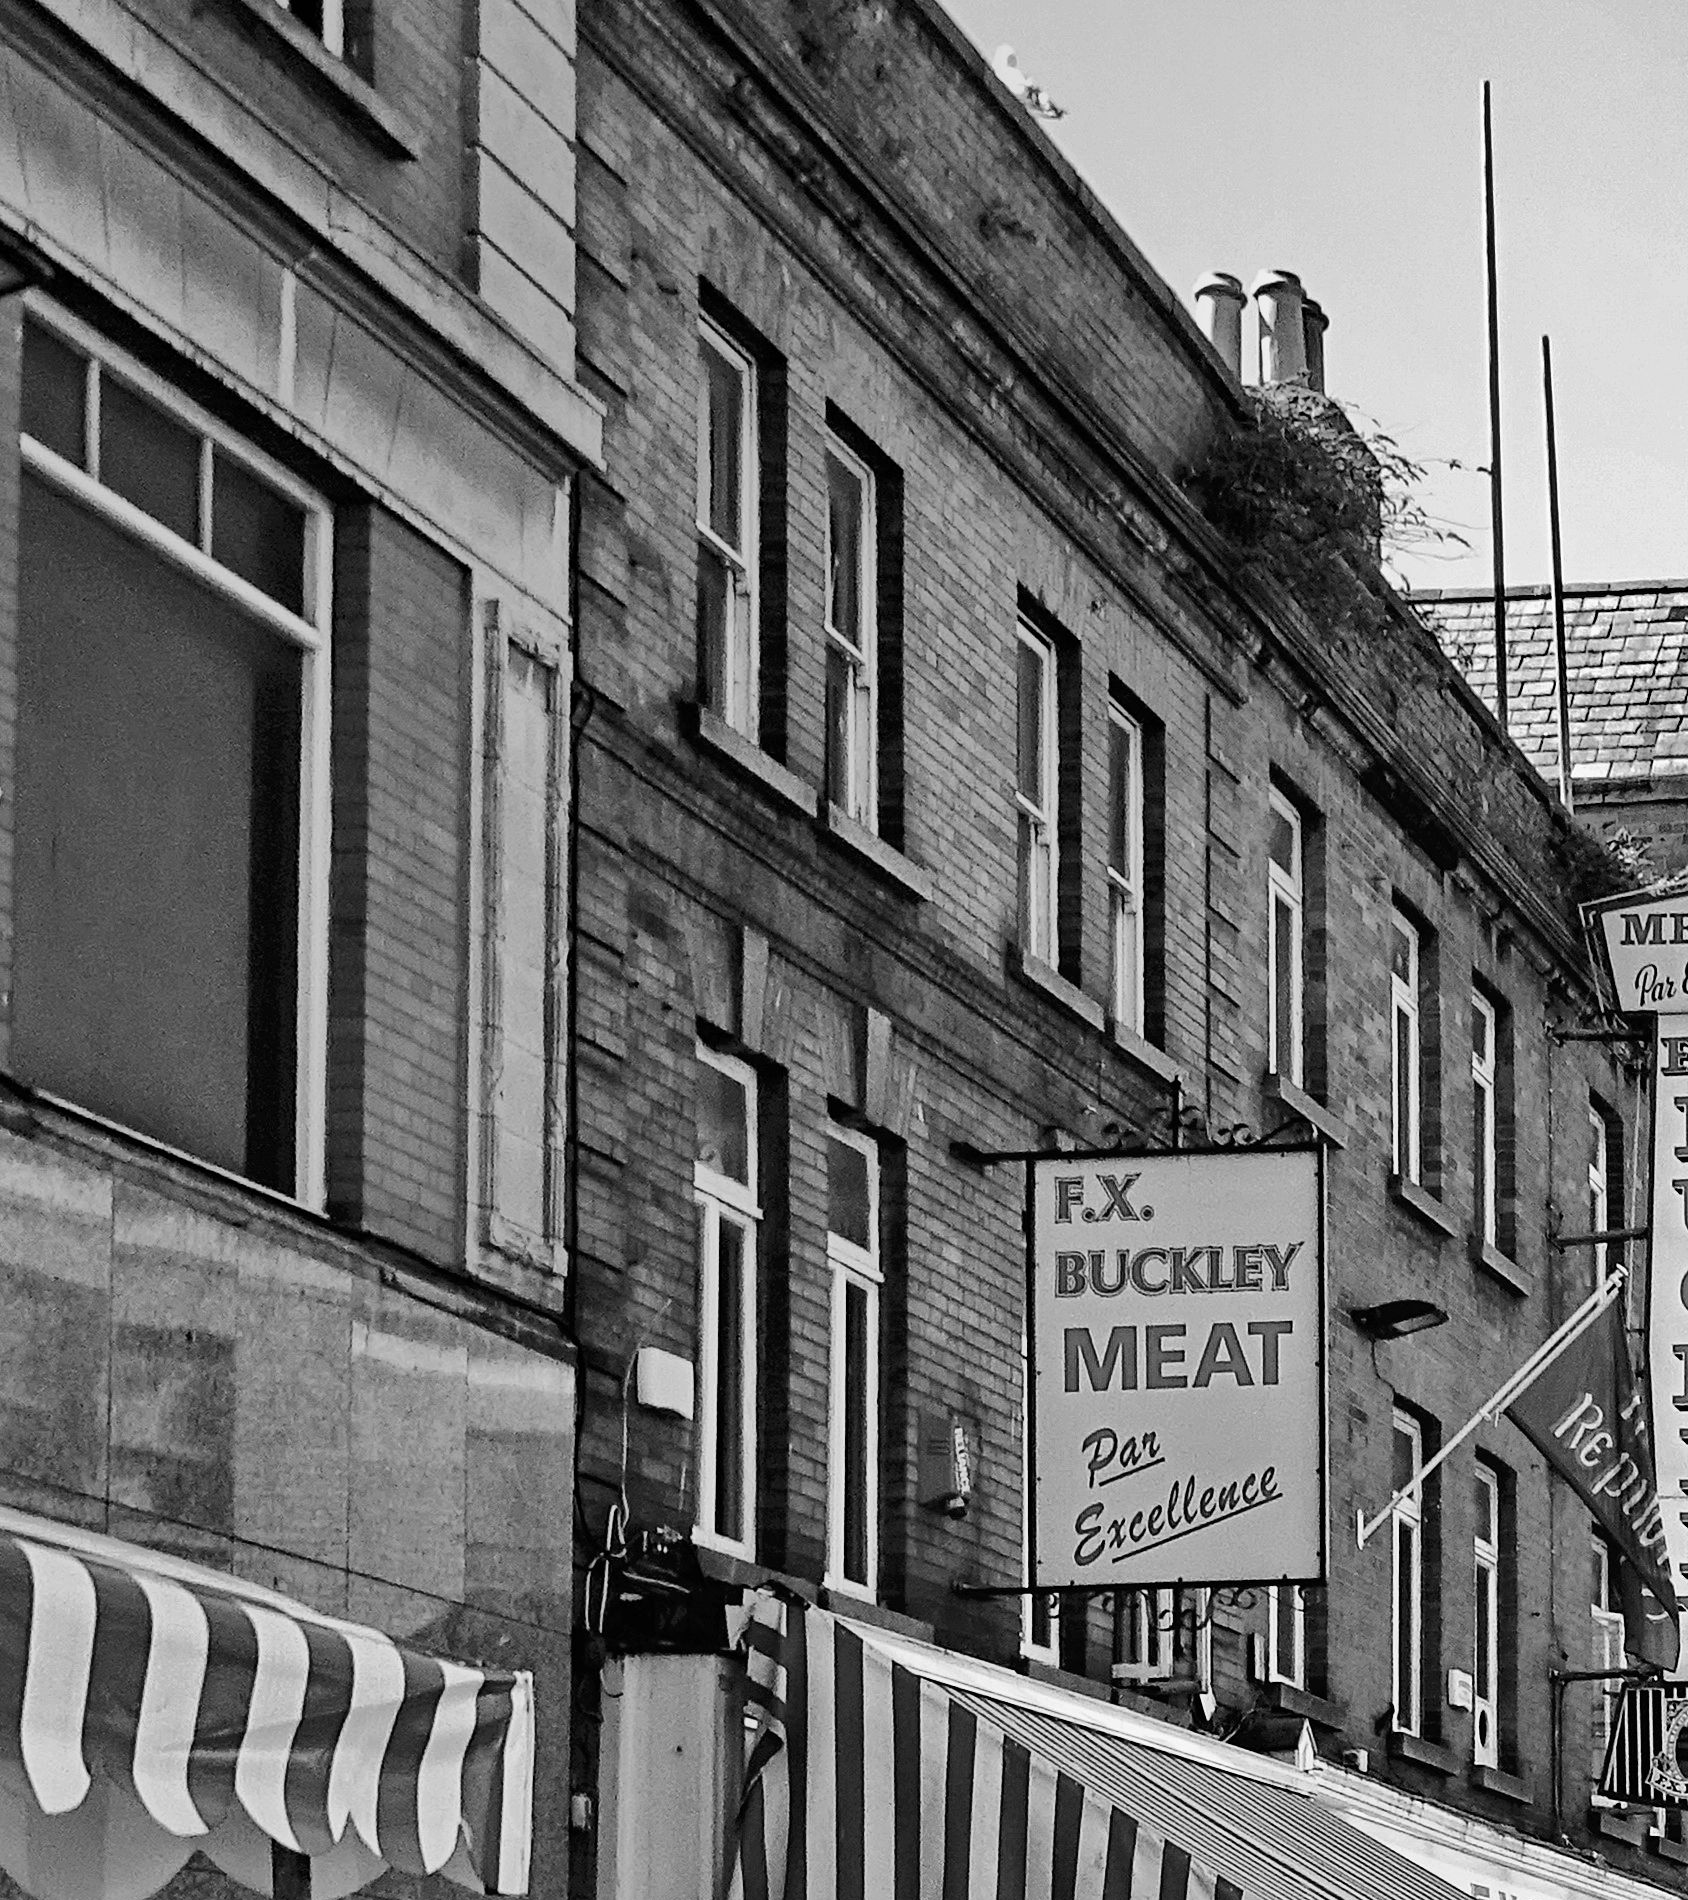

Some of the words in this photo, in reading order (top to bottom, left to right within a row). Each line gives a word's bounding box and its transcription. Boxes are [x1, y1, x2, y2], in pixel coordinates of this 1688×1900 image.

[1634, 963, 1677, 1007] Par
[1054, 1172, 1154, 1224] F.X.
[1055, 1241, 1304, 1297] BUCKLEY
[1063, 1320, 1293, 1393] MEAT
[1081, 1426, 1163, 1489] Par
[1073, 1465, 1281, 1566] Excellence
